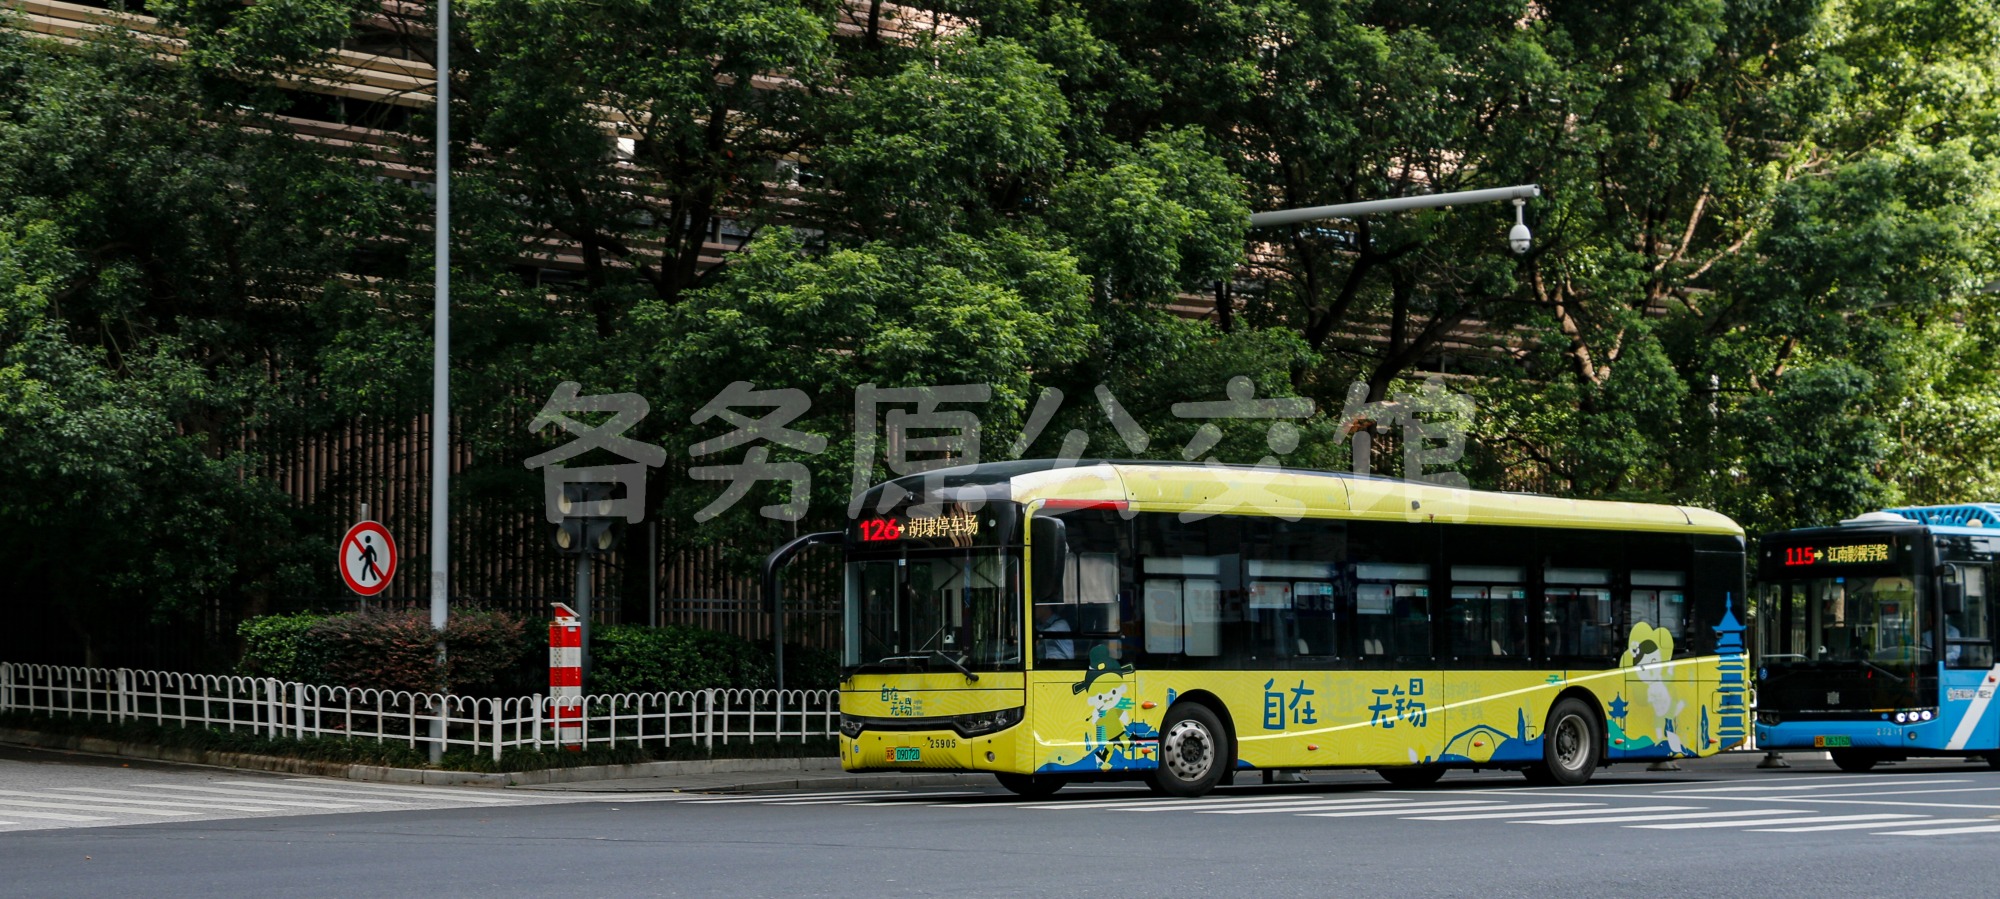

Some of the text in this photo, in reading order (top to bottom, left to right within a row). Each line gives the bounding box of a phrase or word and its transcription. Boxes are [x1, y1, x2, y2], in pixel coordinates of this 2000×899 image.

[860, 518, 899, 541] 126
[908, 514, 978, 538] 胡埭停车场
[1785, 547, 1815, 565] 115
[1828, 544, 1888, 562] 江南影视学院
[881, 683, 898, 701] 自在
[890, 697, 912, 716] 无锡
[1263, 678, 1318, 730] 自在
[1368, 678, 1427, 729] 无锡
[930, 739, 956, 748] 25905
